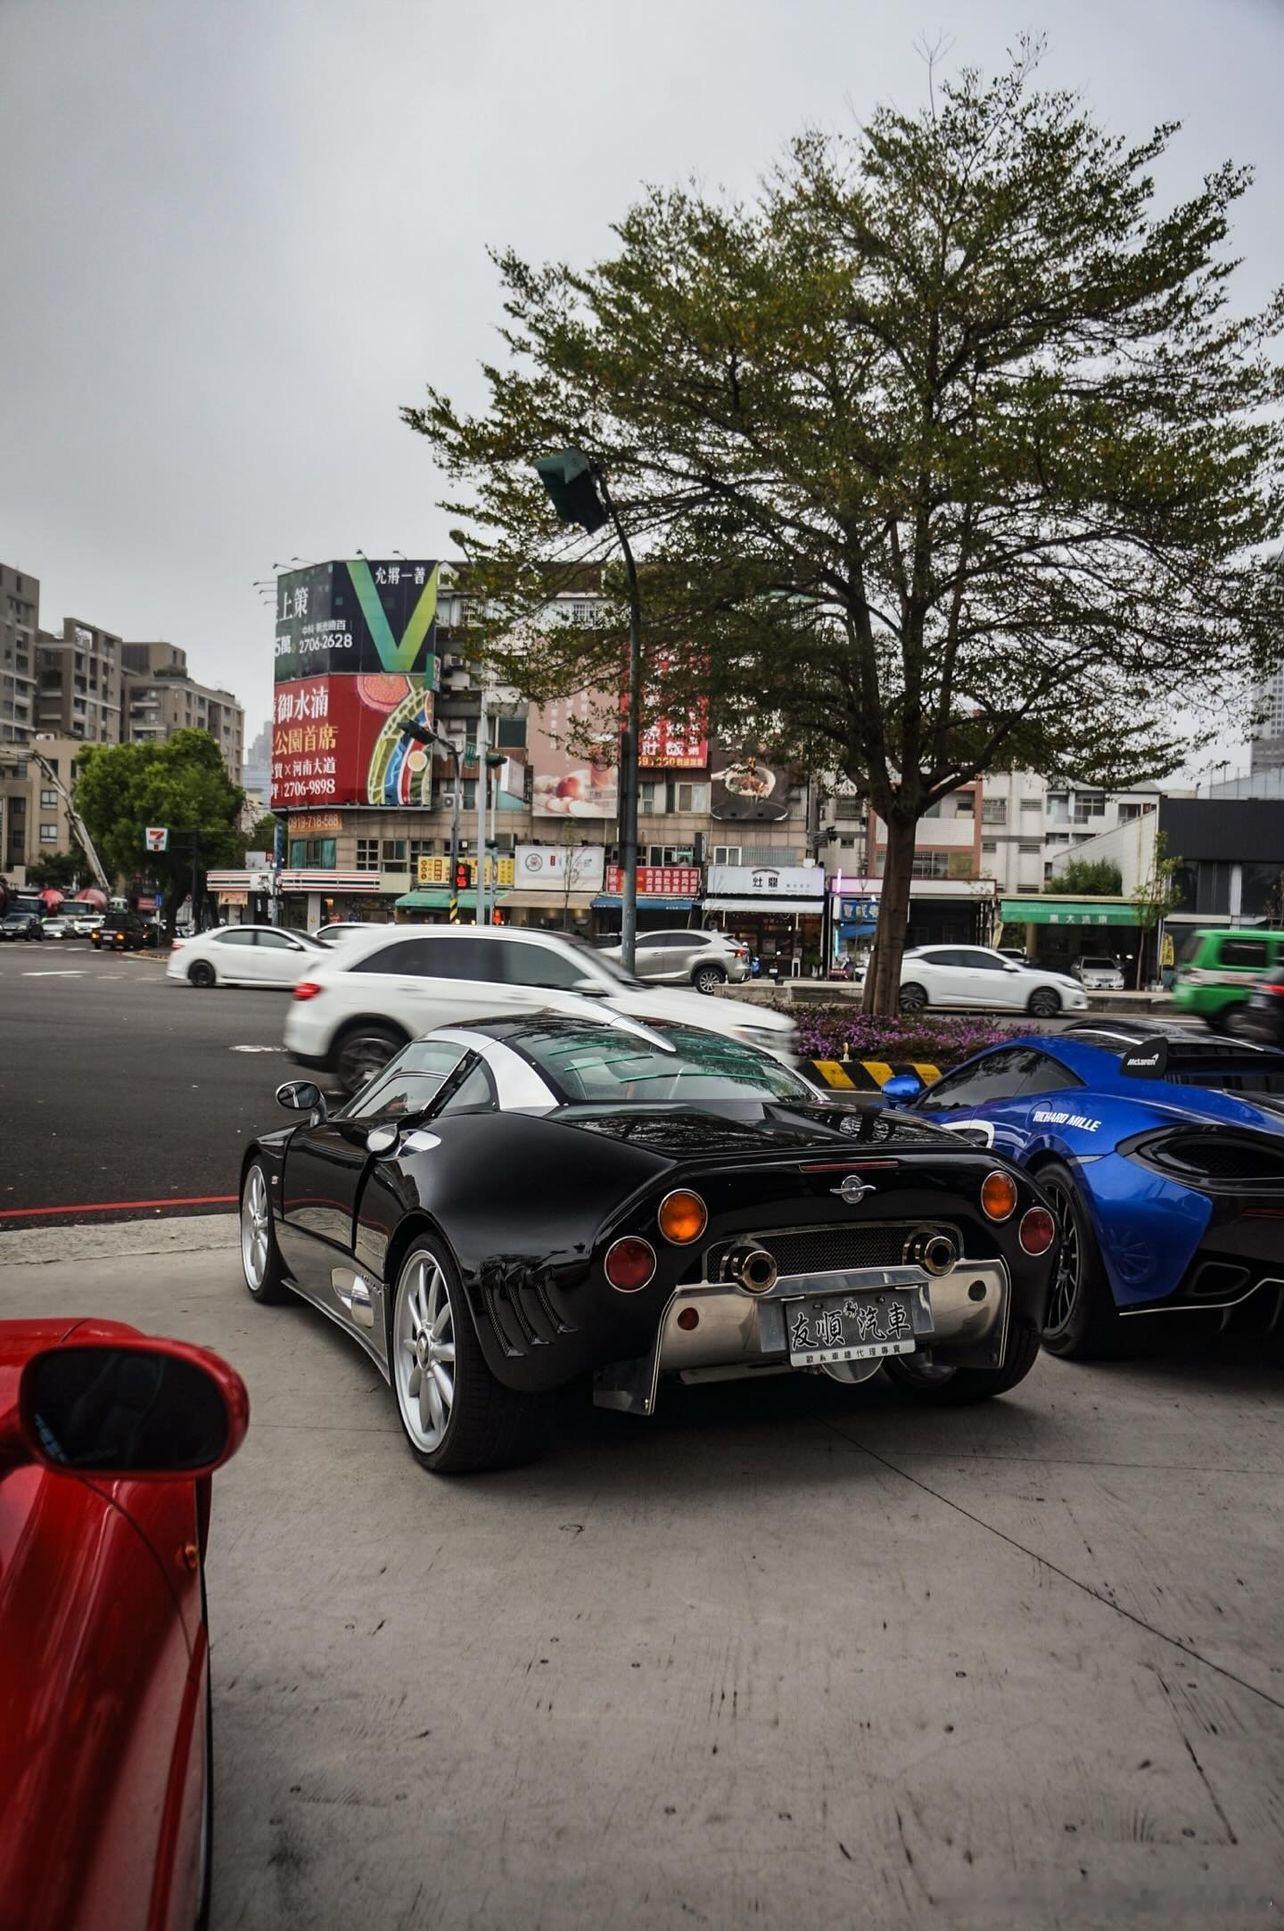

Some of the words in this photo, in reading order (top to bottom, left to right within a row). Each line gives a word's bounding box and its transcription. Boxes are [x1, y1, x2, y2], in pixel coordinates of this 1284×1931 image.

[275, 586, 309, 622] 上策
[299, 633, 353, 654] 2706-2628
[271, 724, 339, 756] 公園首席
[284, 778, 336, 798] 2706-9898
[1127, 1057, 1156, 1066] McLaren
[1033, 1110, 1069, 1124] RICHARD
[1066, 1114, 1102, 1132] MILLE
[790, 1301, 912, 1351] 友順汽車
